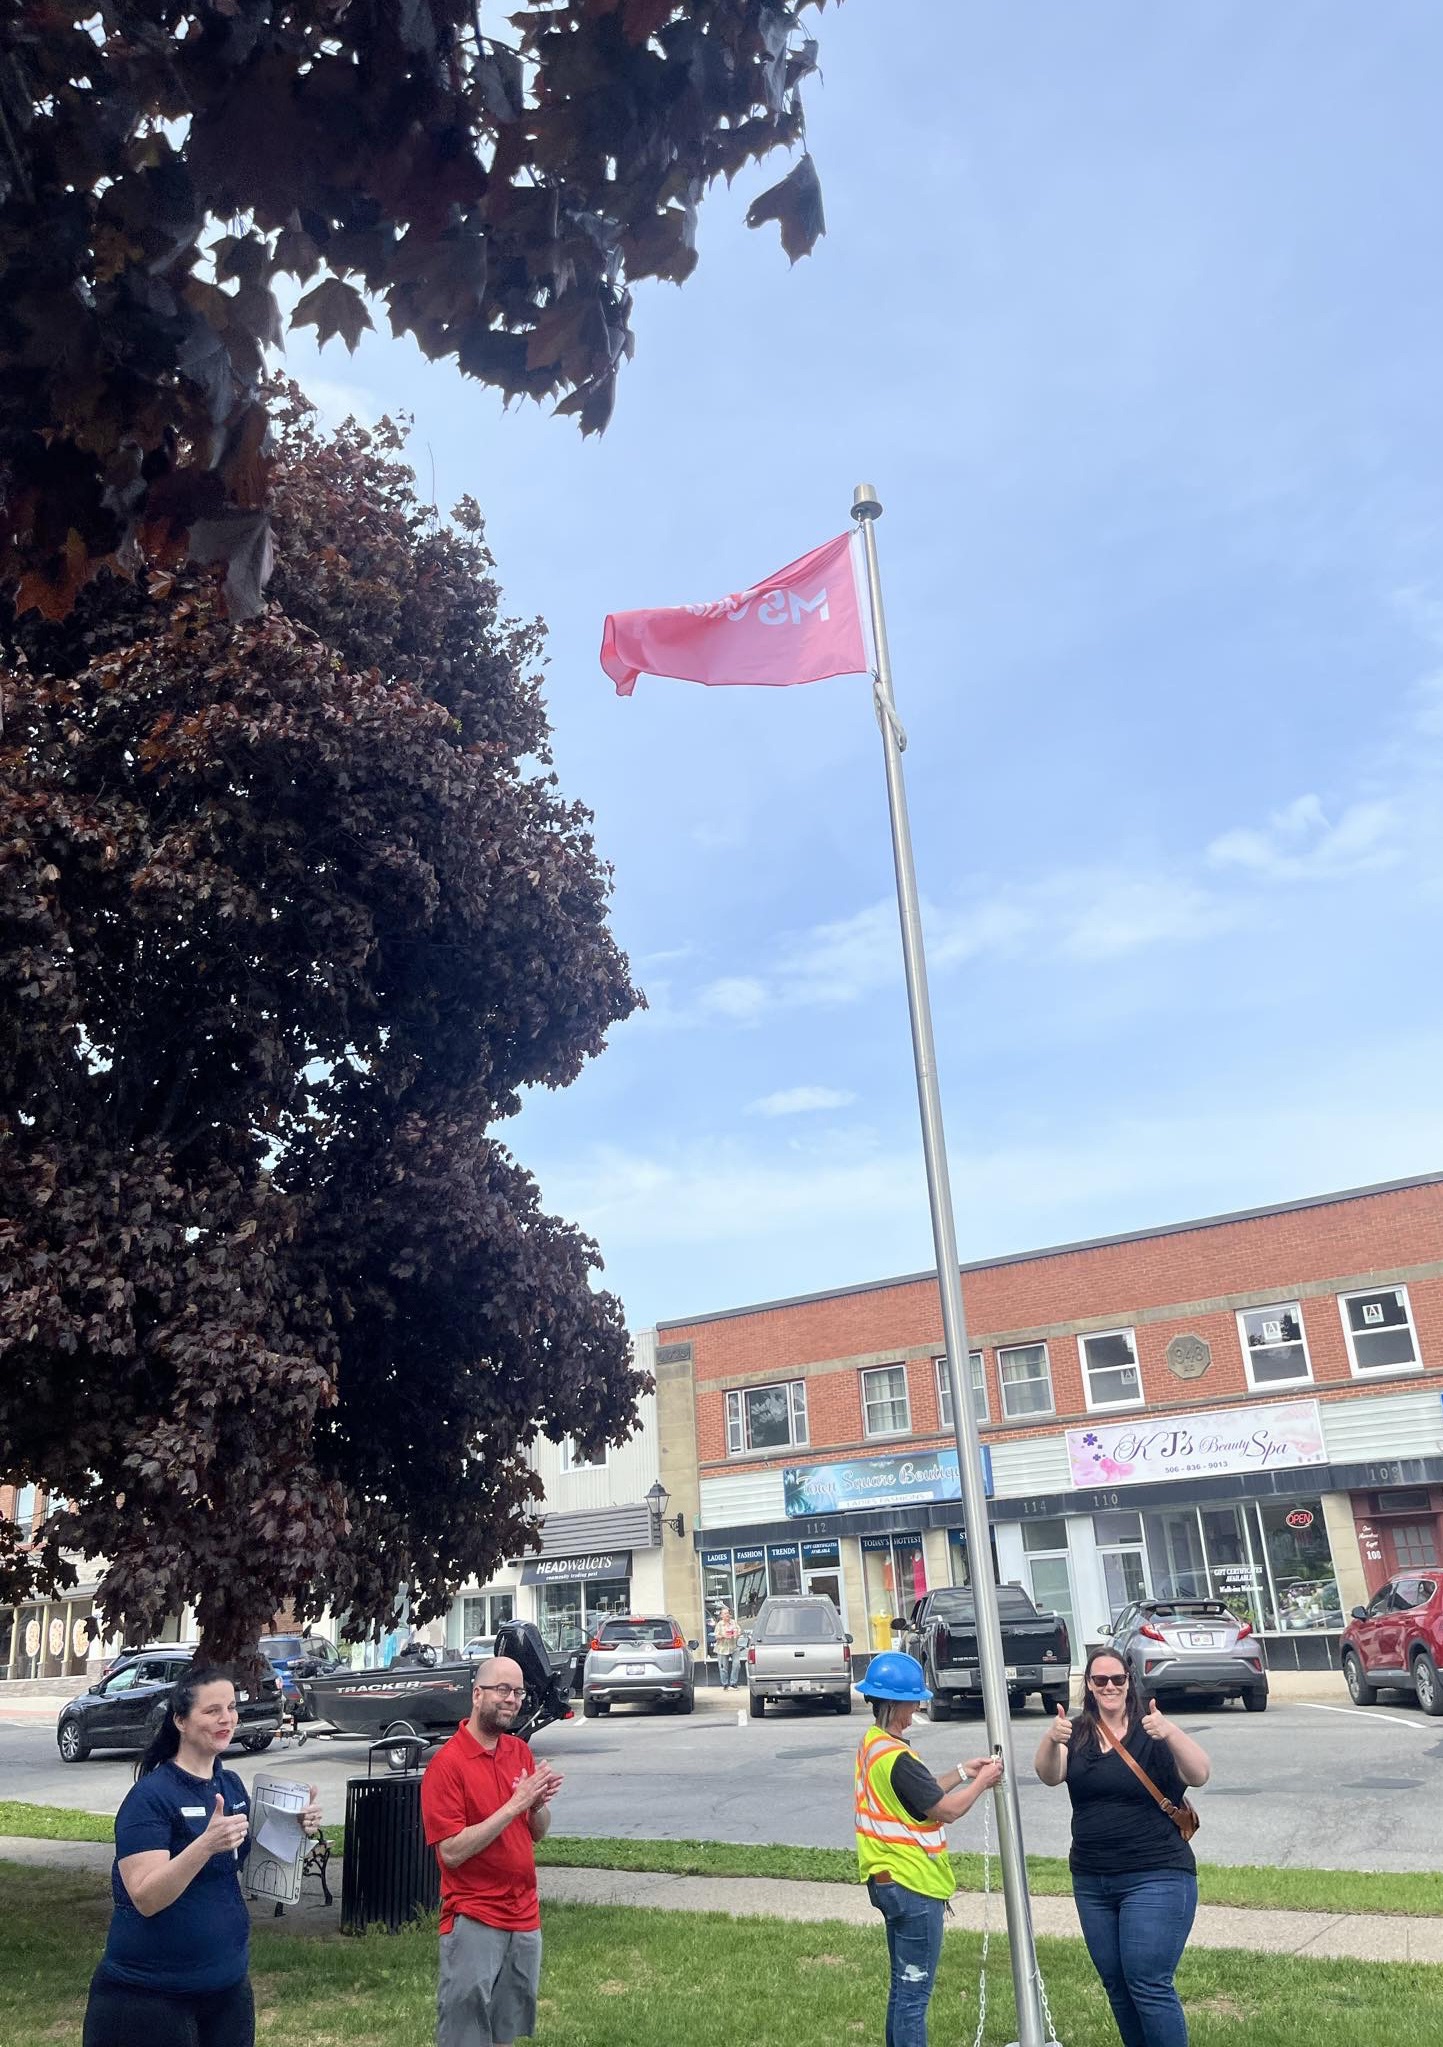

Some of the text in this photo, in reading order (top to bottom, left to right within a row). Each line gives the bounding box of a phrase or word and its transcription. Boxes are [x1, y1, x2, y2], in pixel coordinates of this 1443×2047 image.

[1199, 1435, 1249, 1457] Beauty
[1246, 1430, 1288, 1464] Spa
[841, 1470, 897, 1494] Square
[900, 1462, 960, 1485] Boutiqu
[846, 1493, 927, 1507] LADIES FASHIONS
[1024, 1501, 1047, 1513] 114
[1094, 1494, 1118, 1507] 110
[1289, 1513, 1311, 1524] OPEN
[806, 1522, 827, 1534] 112
[864, 1535, 922, 1547] TODAY'S HOTTEST
[707, 1547, 796, 1562] LADIES FASHION TRENDS
[536, 1555, 613, 1575] HEADwaters
[336, 1680, 421, 1694] TRACKER
